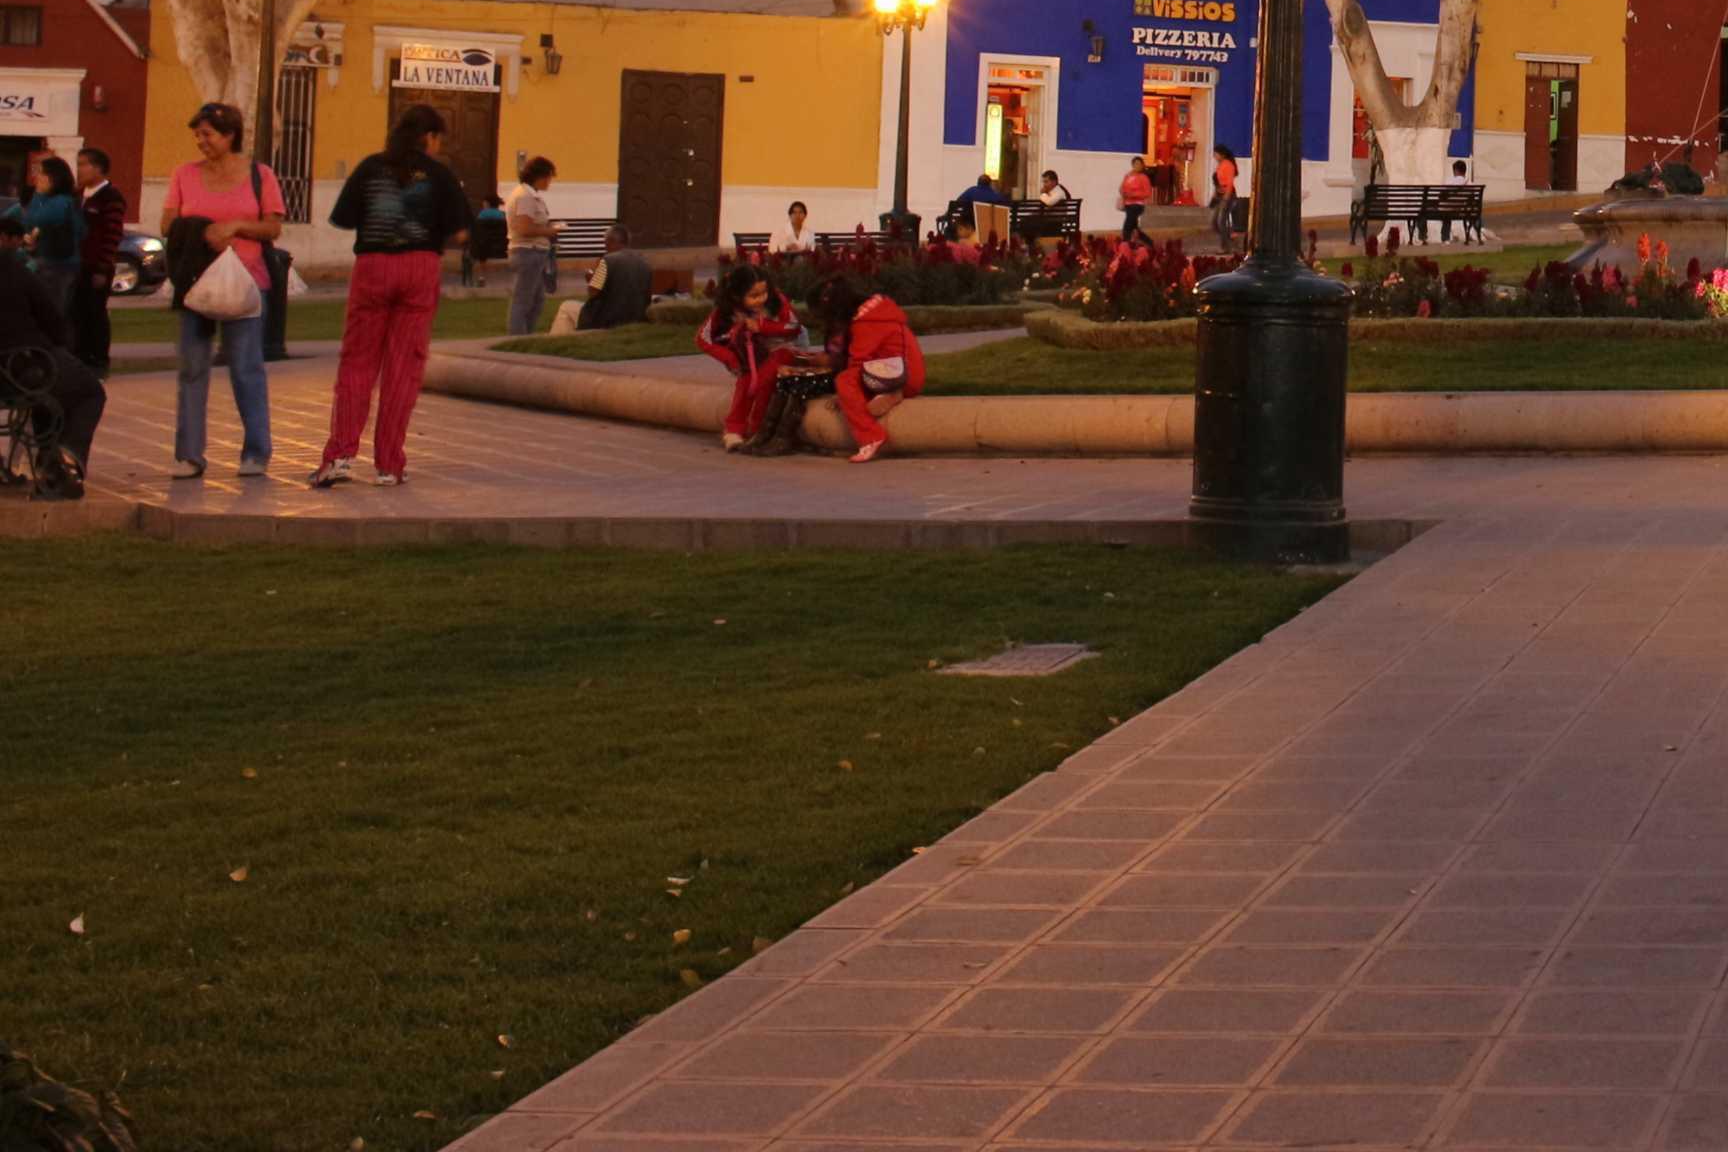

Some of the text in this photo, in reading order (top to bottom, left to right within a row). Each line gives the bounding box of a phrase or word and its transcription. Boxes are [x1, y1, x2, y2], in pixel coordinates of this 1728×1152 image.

[1132, 27, 1237, 49] PIZZERIA
[1136, 46, 1229, 63] Delivery 797743
[403, 65, 489, 86] LA VENTANA
[0, 95, 35, 110] SA
